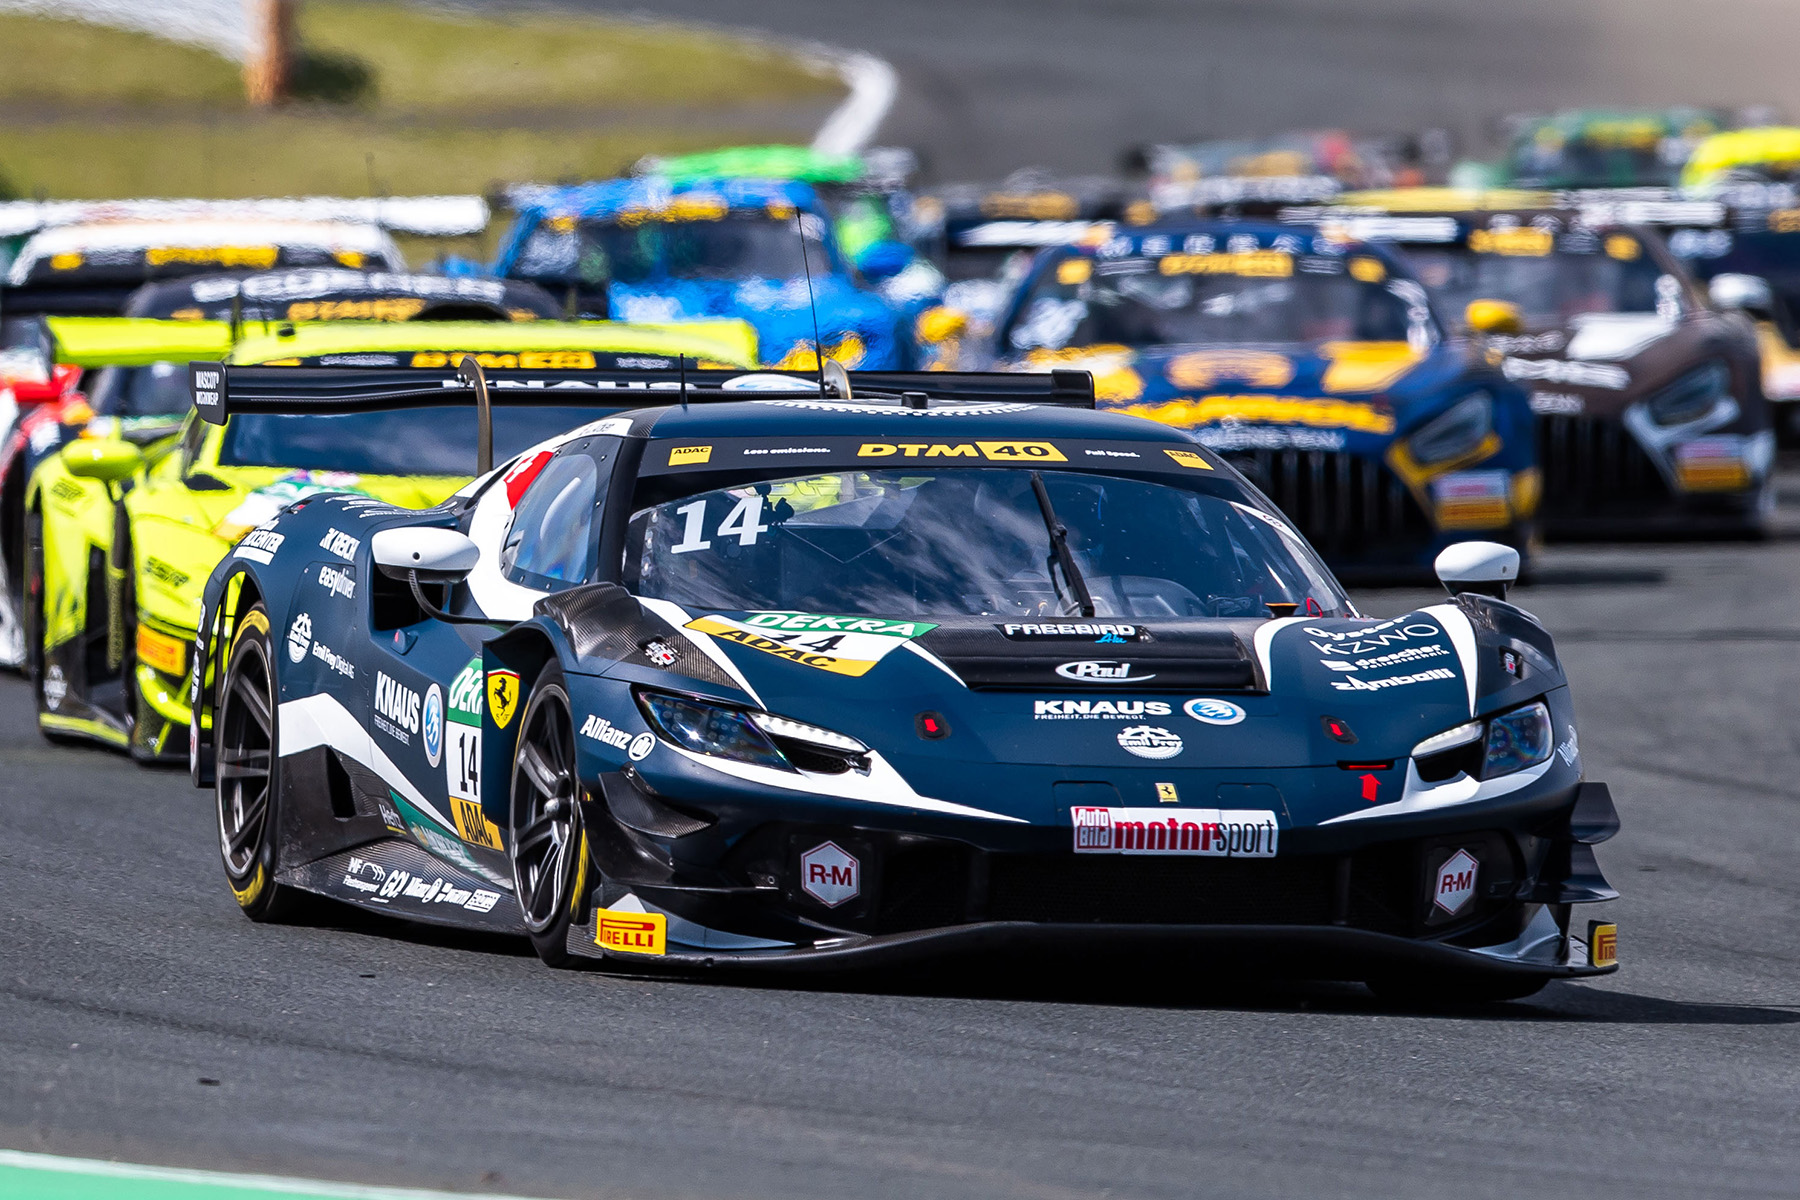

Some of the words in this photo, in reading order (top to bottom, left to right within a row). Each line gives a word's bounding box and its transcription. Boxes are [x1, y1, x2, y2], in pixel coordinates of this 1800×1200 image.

[857, 444, 980, 457] DTM
[993, 445, 1050, 456] 40
[1166, 450, 1199, 460] ADAC
[671, 496, 768, 554] 14
[746, 614, 916, 636] DEKRA
[1003, 623, 1136, 636] FREEBIRD
[718, 630, 837, 667] ADAC
[760, 633, 846, 652] 14
[1094, 632, 1128, 644] Alu
[1309, 624, 1440, 655] KZWO
[1355, 644, 1441, 666] drescher
[1075, 662, 1131, 679] Paul
[374, 670, 420, 735] KNAUS
[1034, 700, 1173, 715] KNAUS
[580, 714, 633, 750] Allianz
[1119, 738, 1150, 747] Emil
[1152, 738, 1183, 748] Frey
[459, 732, 479, 796] 14
[379, 803, 405, 830] Hertz
[460, 801, 494, 847] ADAC
[1075, 808, 1109, 826] Auto
[1079, 827, 1110, 847] Bild
[379, 870, 410, 898] GO!
[600, 918, 656, 948] PIRELLI
